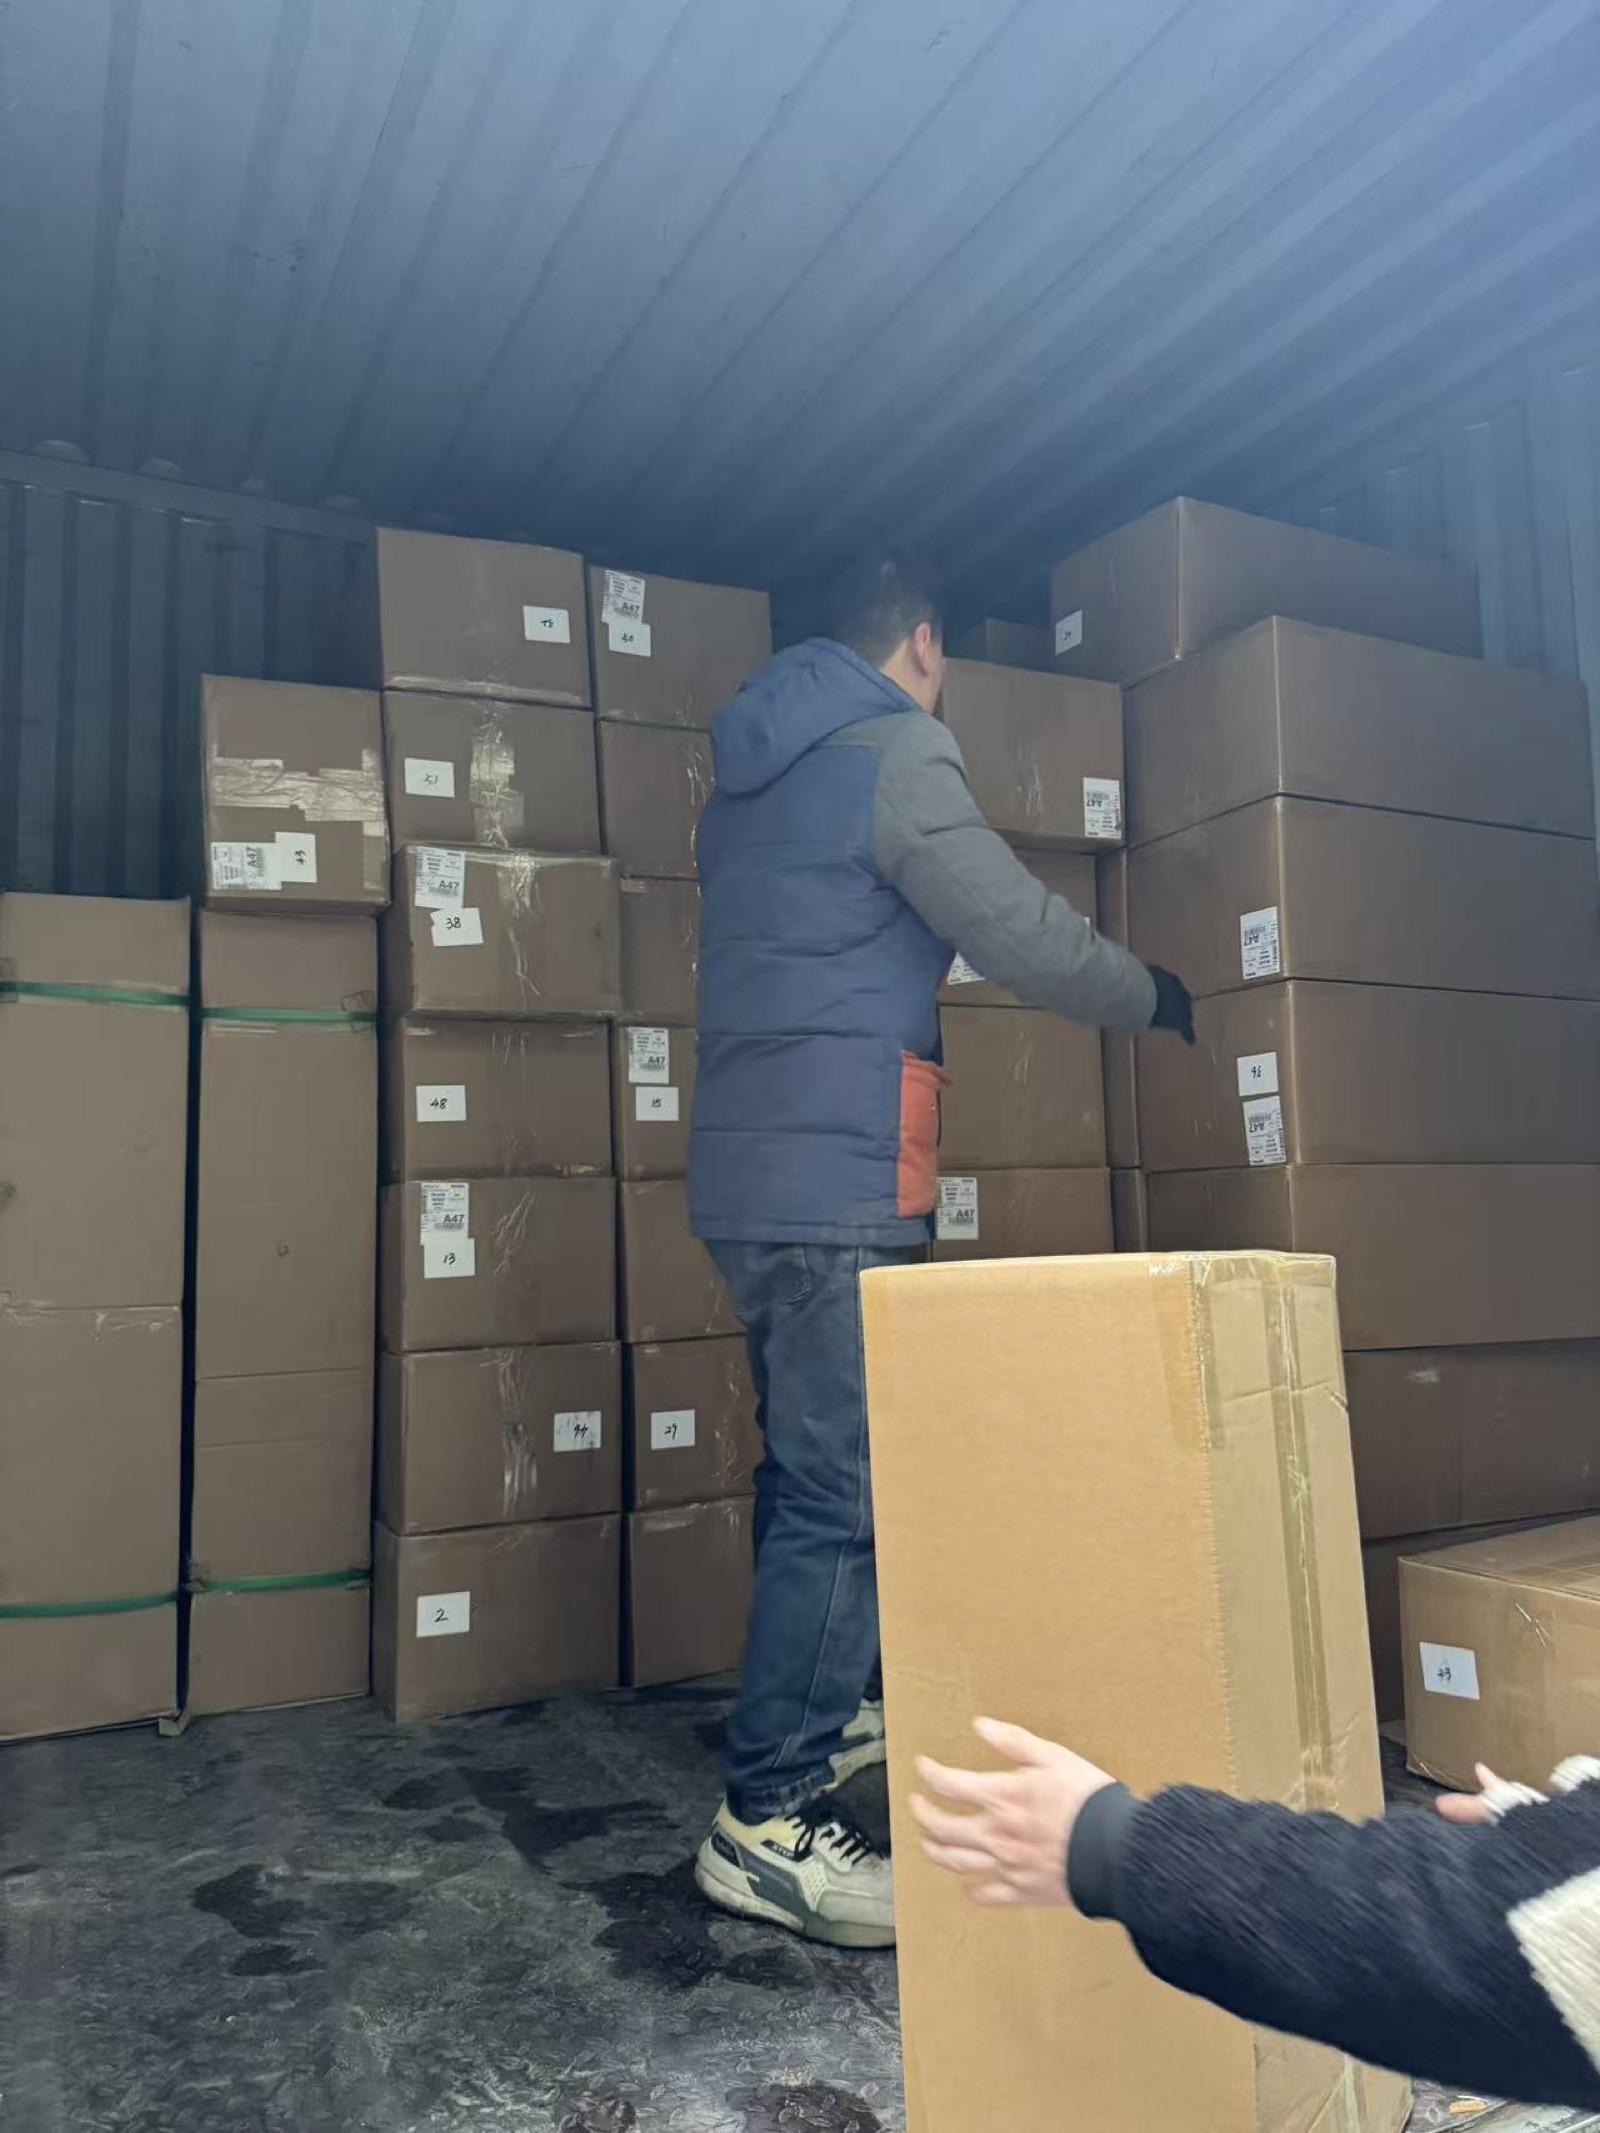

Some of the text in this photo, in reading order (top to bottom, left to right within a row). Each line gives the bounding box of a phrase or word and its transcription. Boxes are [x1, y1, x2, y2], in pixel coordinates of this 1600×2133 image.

[622, 601, 640, 614] A47
[246, 846, 259, 869] A47
[439, 880, 460, 891] A47
[446, 916, 462, 931] 38
[648, 1055, 666, 1065] A47
[430, 1097, 448, 1110] 48
[1249, 1122, 1265, 1133] A47
[443, 1214, 465, 1224] A47
[957, 1209, 975, 1218] A47
[443, 1252, 456, 1266] 13
[664, 1422, 678, 1441] 29
[434, 1607, 450, 1623] 2
